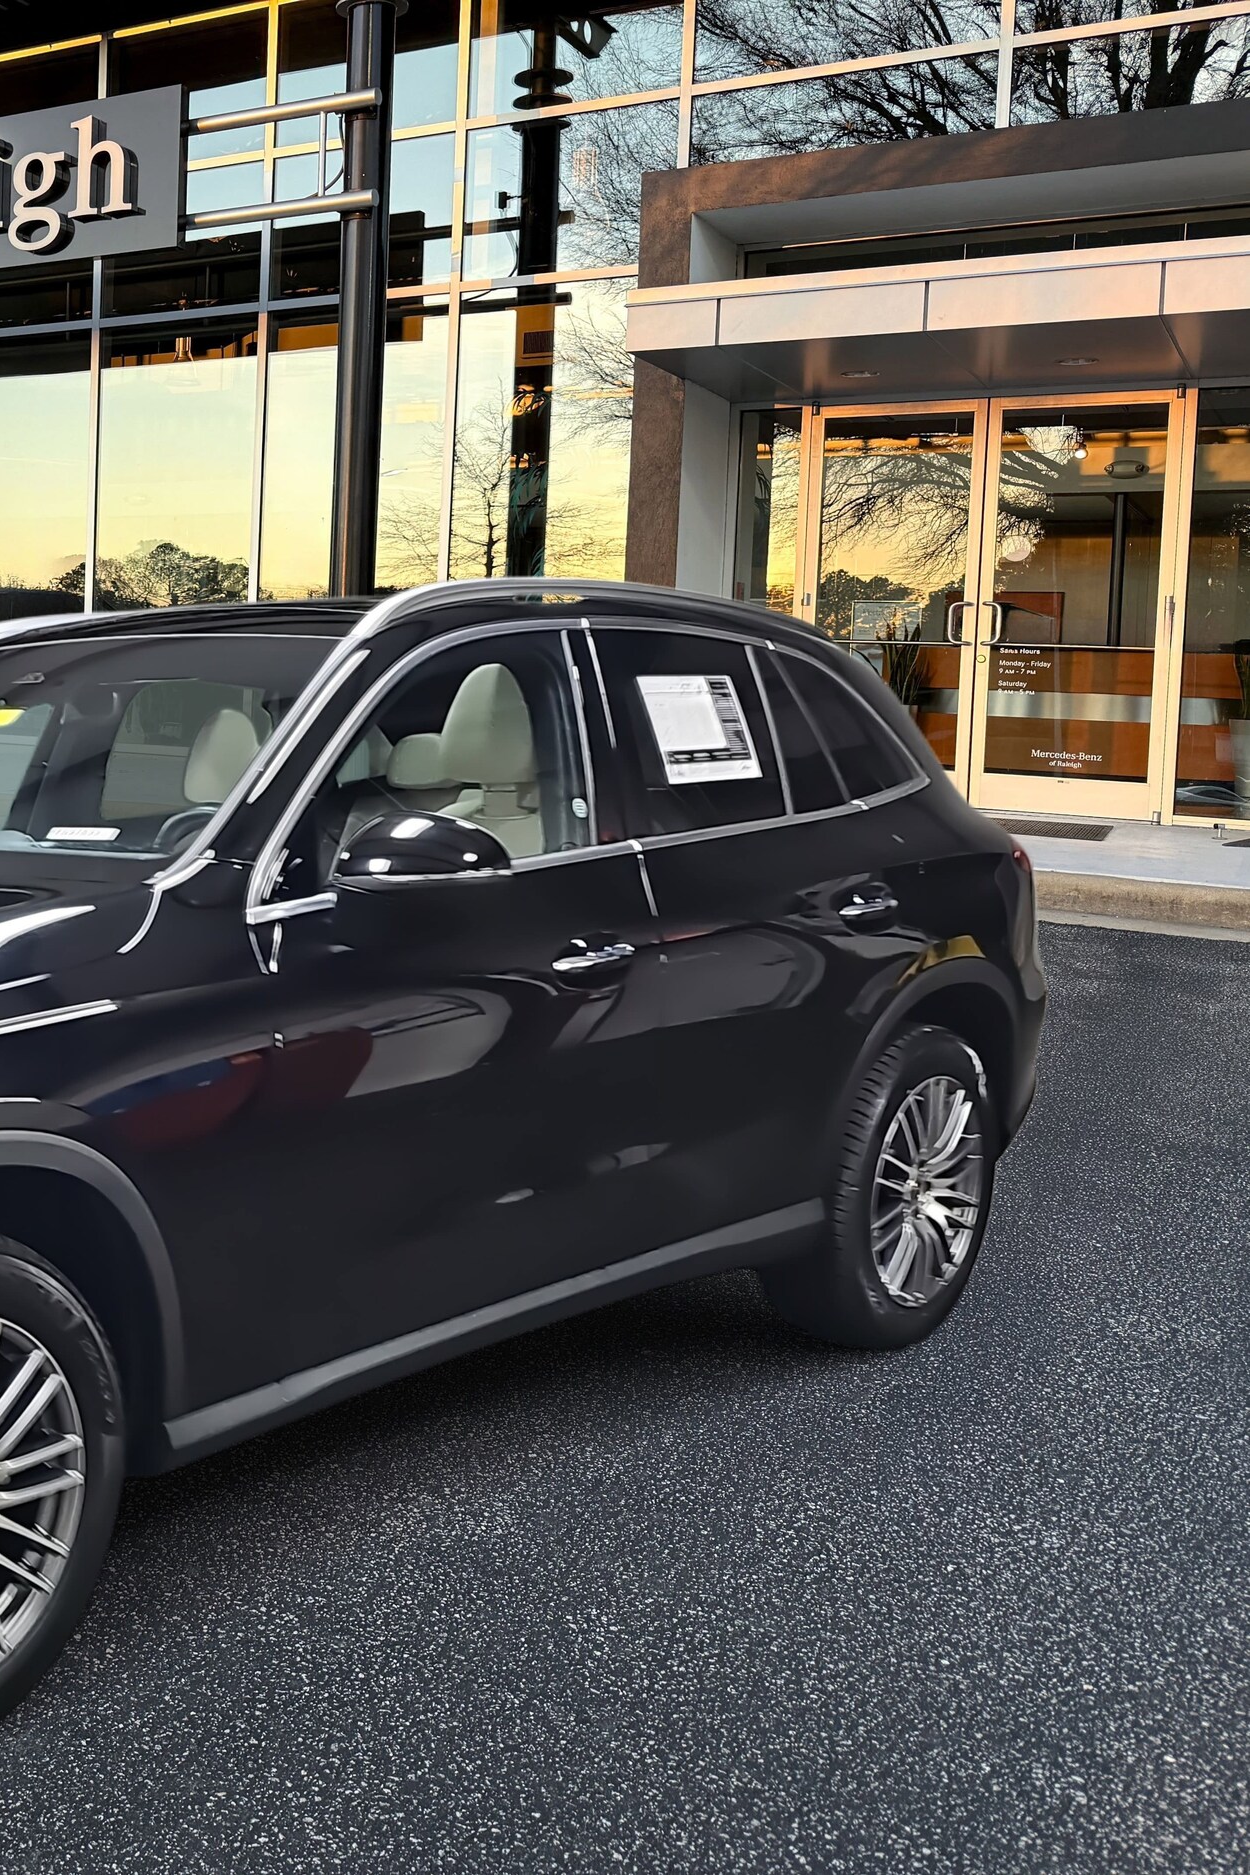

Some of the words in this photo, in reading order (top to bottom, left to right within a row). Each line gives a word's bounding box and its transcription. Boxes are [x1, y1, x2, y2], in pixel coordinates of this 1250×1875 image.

[998, 660, 1025, 668] Monday
[1030, 660, 1051, 669] Friday
[997, 680, 1027, 688] Saturday
[1030, 749, 1103, 762] Mercedes-Benz
[1057, 761, 1083, 769] Raleigh
